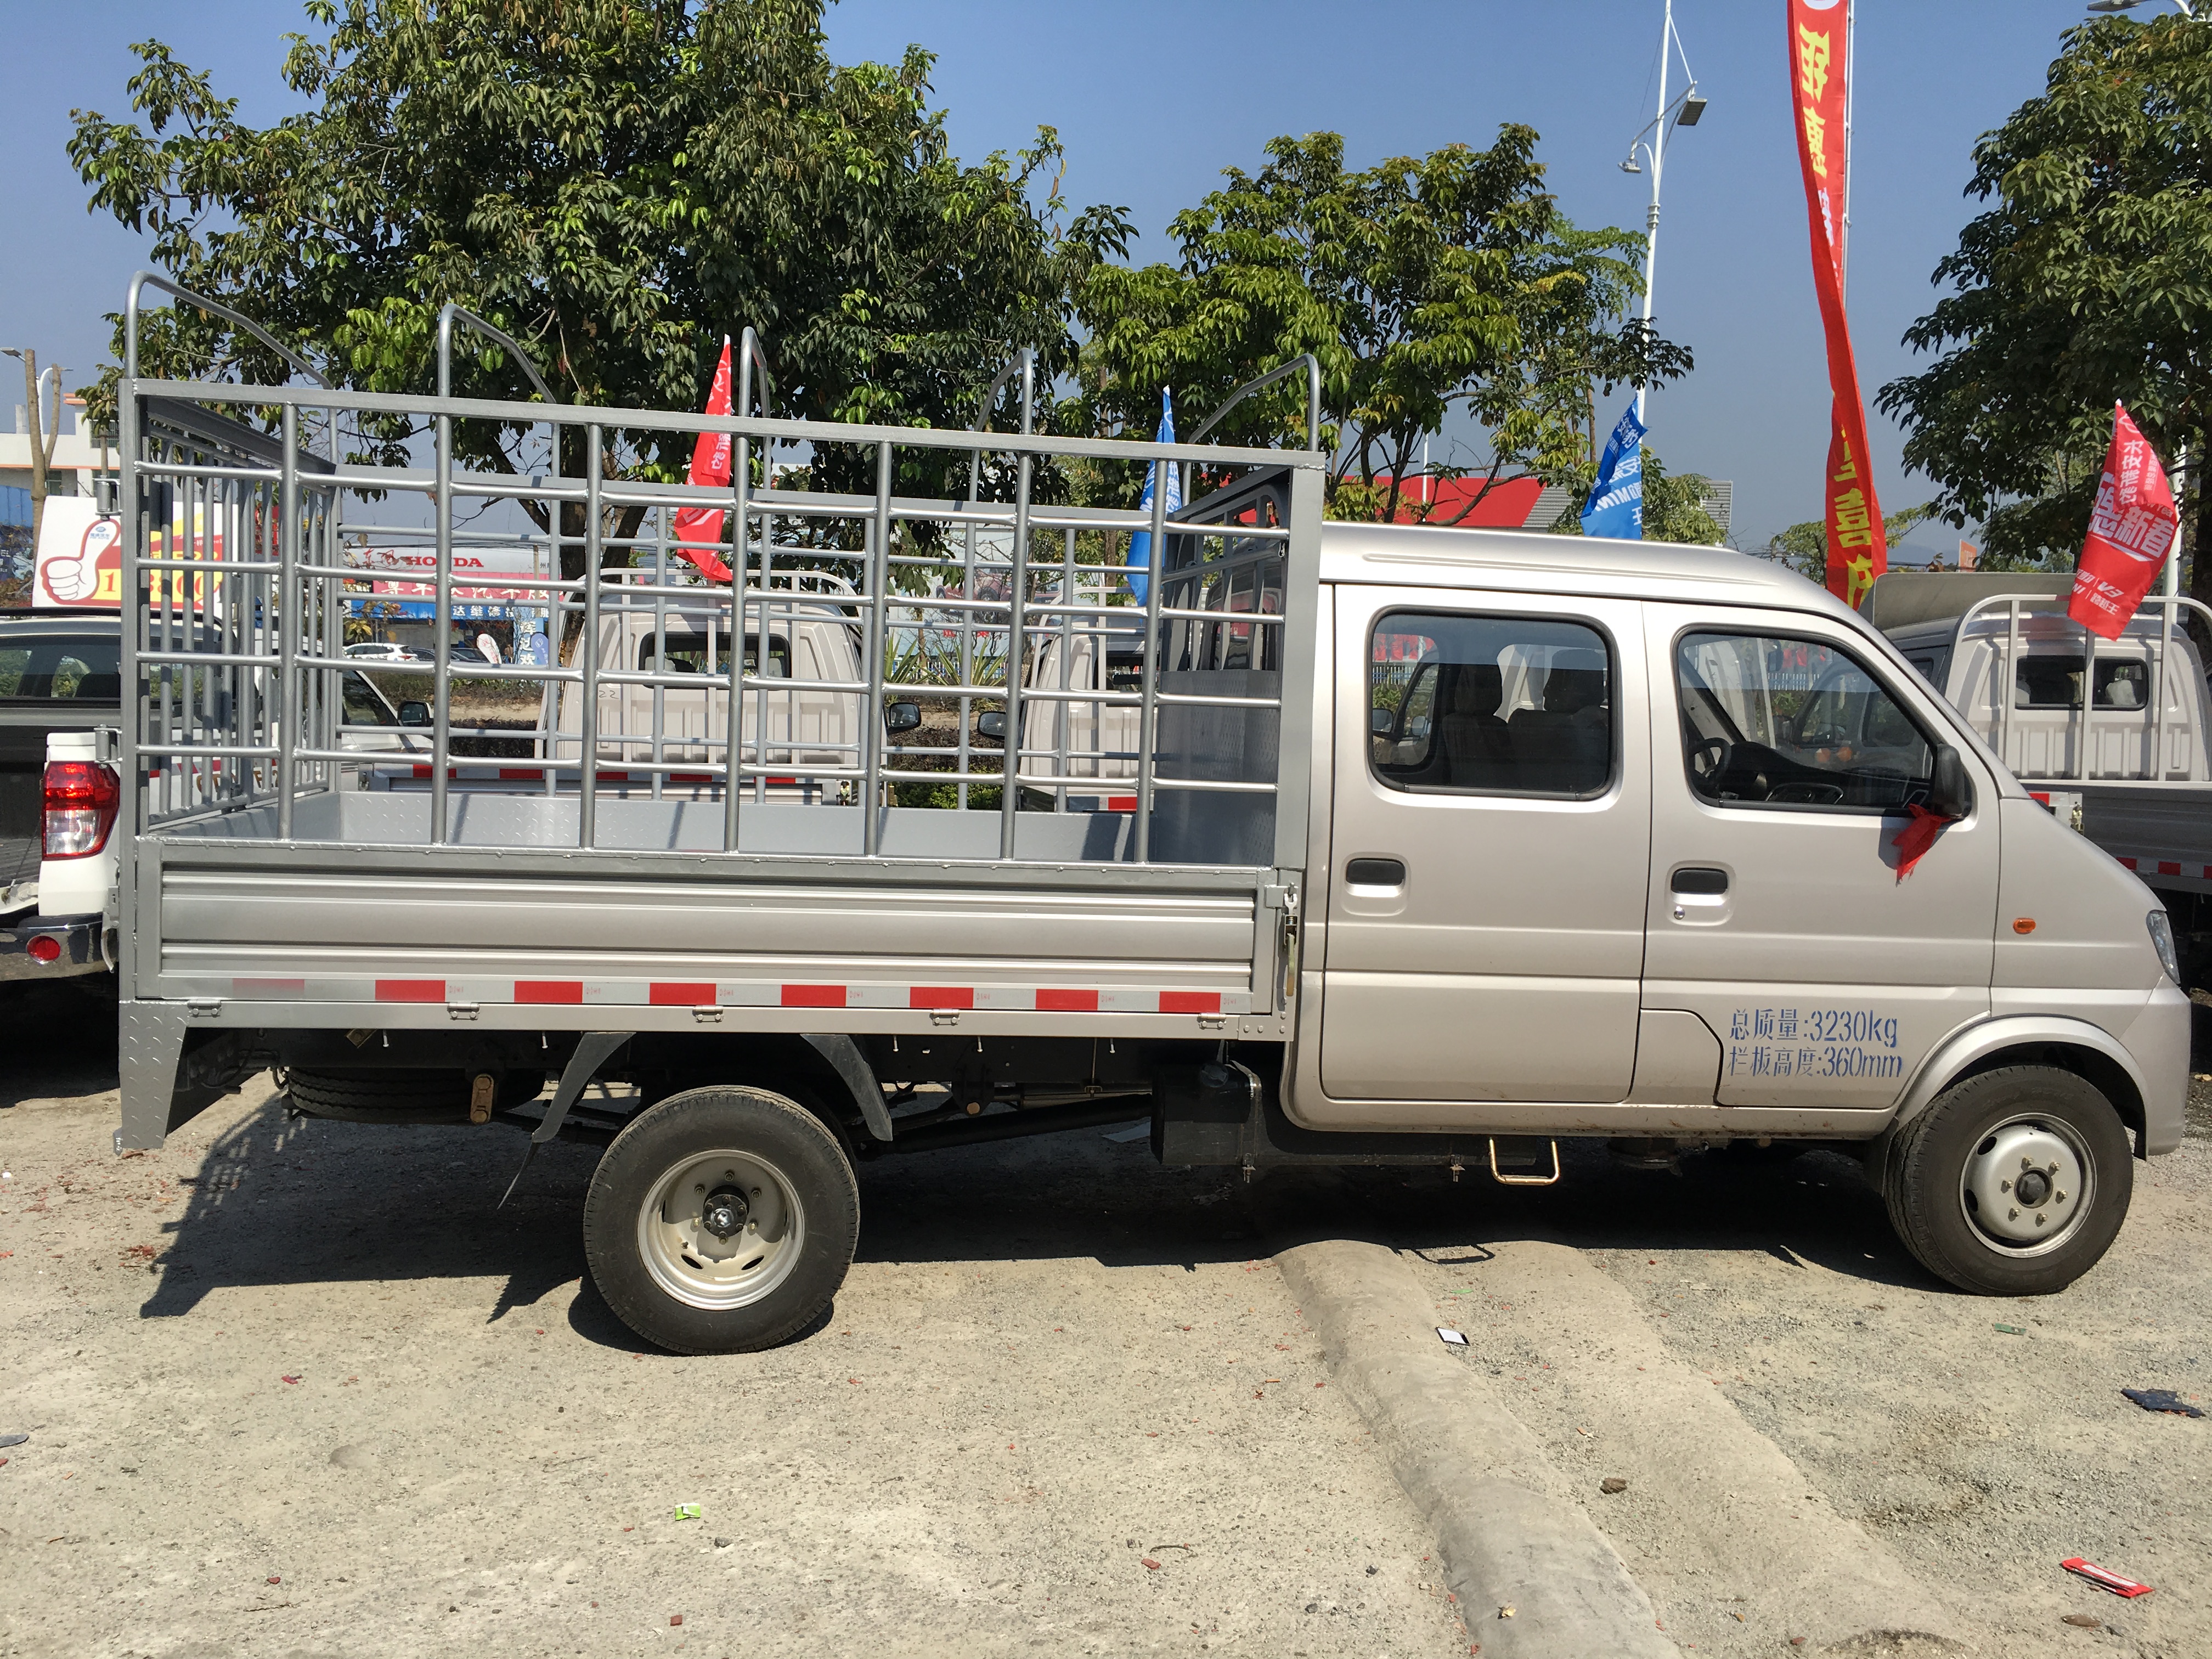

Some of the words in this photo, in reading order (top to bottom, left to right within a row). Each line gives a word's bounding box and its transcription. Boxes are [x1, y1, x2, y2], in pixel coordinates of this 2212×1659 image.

[405, 556, 484, 567] HODA
[1729, 1008, 1898, 1048] 总质量:3230kg
[1727, 1046, 1904, 1079] 栏板高度:360mm
